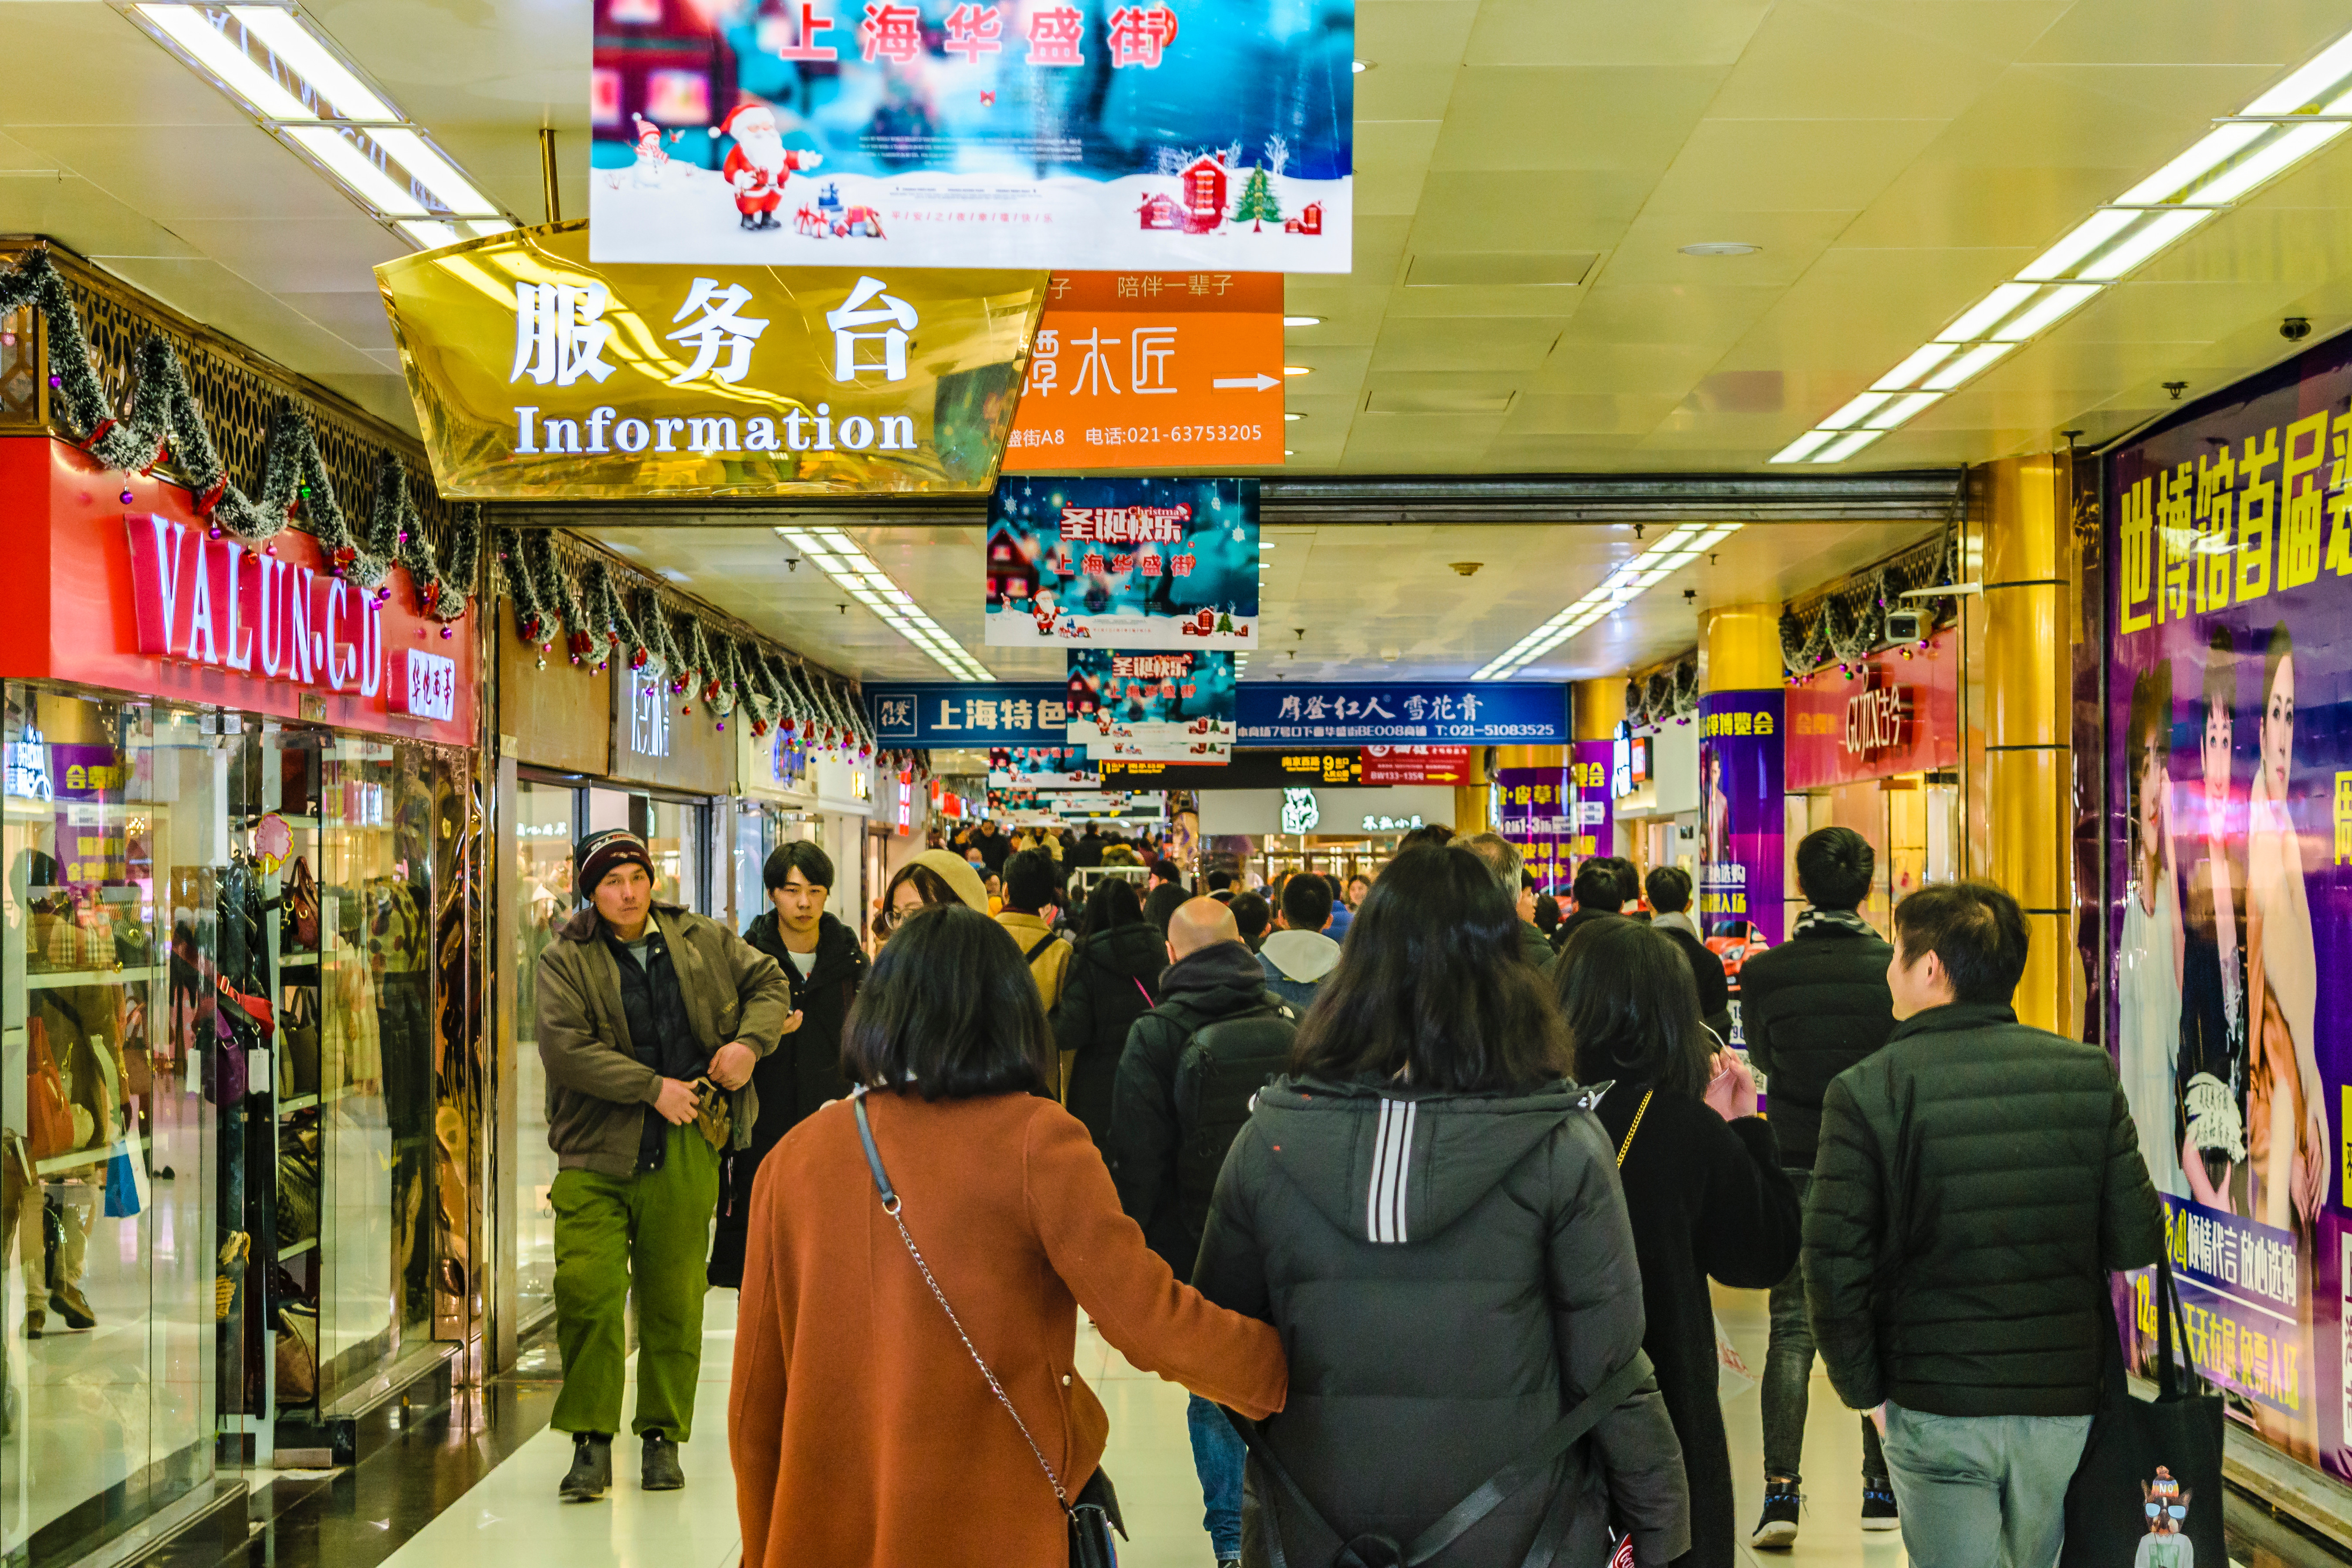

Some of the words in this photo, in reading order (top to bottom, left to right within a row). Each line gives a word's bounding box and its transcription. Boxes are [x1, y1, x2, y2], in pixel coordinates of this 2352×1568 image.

[782, 2, 1166, 68] 上海华盛街
[1118, 274, 1234, 298] 陪伴一辈子
[510, 276, 919, 386] 服务台
[514, 402, 918, 454] Information
[1085, 424, 1262, 446] 电话:021-63753205
[1060, 507, 1182, 545] 圣诞快乐
[1128, 506, 1184, 516] Christma
[1053, 553, 1192, 577] 上海华盛街
[930, 699, 1067, 730] 上海特色
[2241, 1229, 2297, 1307] 放心选购
[2159, 1483, 2174, 1493] NO
